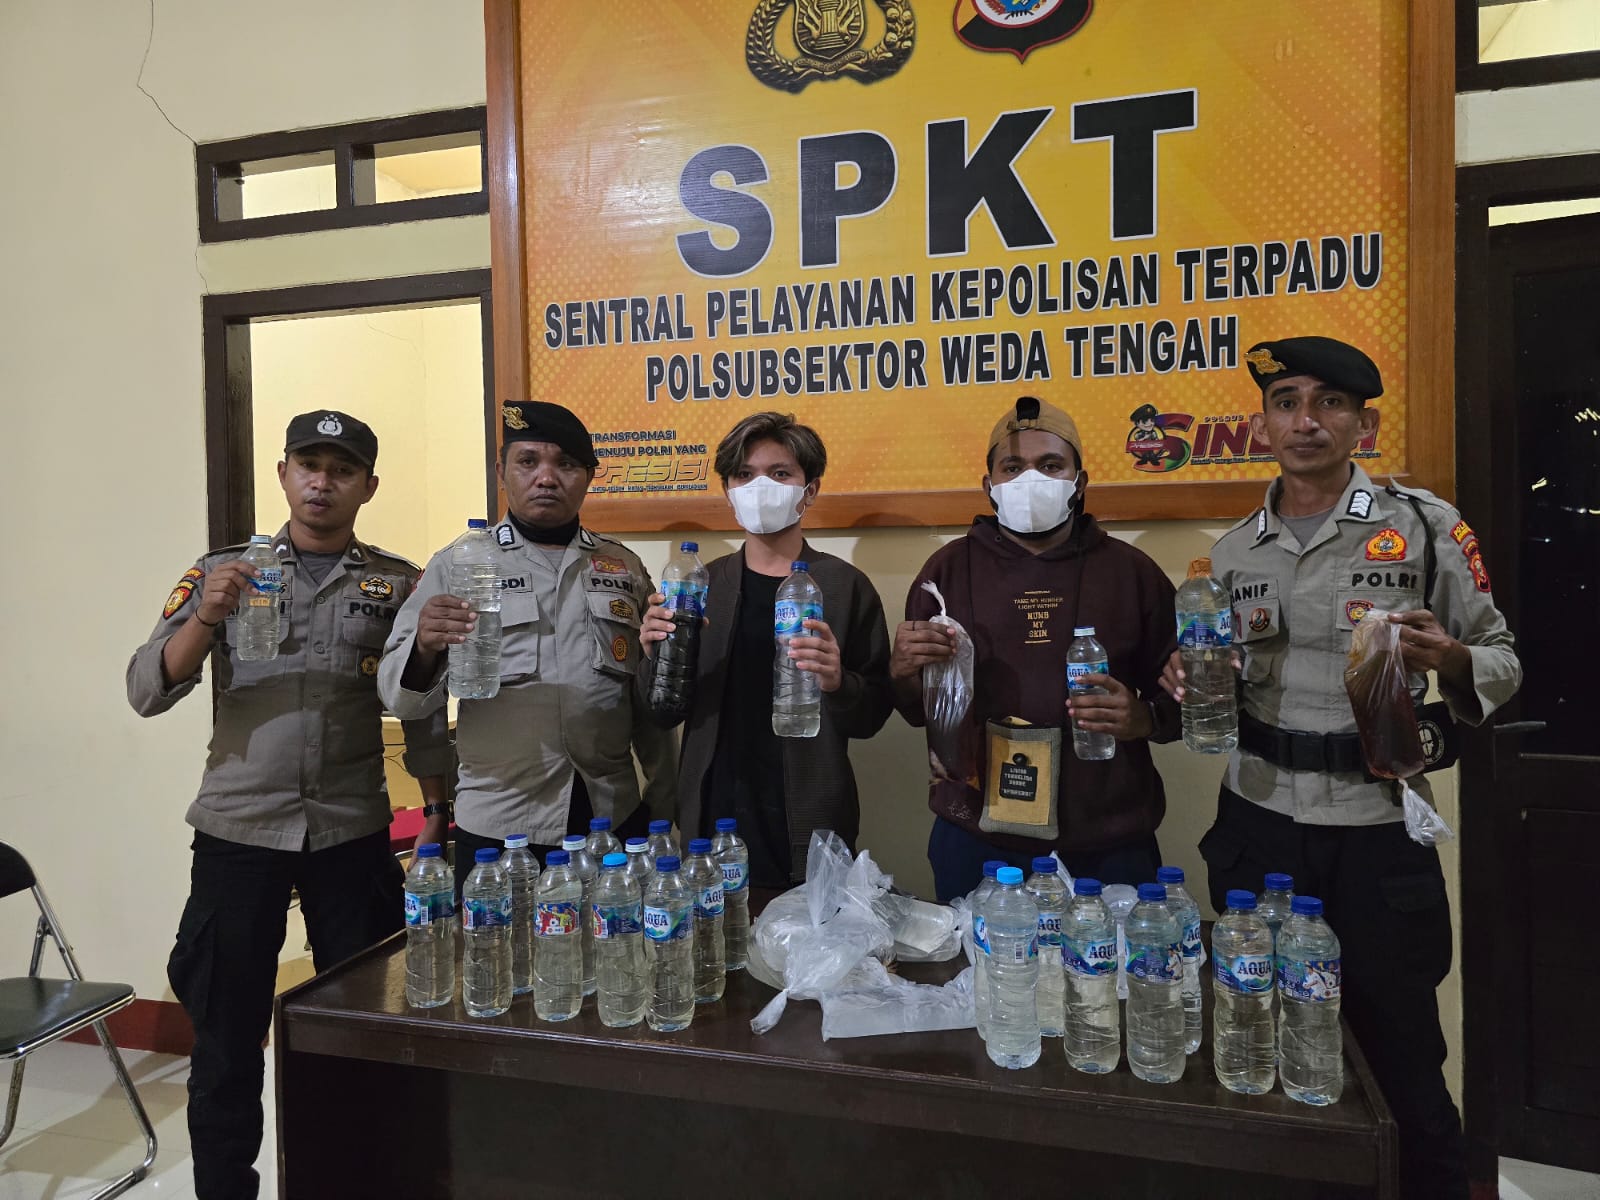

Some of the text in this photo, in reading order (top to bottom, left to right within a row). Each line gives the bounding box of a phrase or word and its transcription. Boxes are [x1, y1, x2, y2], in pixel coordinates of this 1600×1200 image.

[676, 89, 1198, 278] SPKT
[545, 233, 1383, 350] SENTRAL PELAYANAN KEPOLISAN TERPADU
[645, 315, 1239, 403] POLSUBSEKTOR WEDA TENGAH
[638, 445, 673, 457] POLRI
[675, 444, 708, 456] YANG
[260, 572, 281, 583] AQU
[1352, 572, 1418, 589] POLRI
[591, 578, 634, 593] POLRI
[1033, 620, 1044, 629] MY
[1028, 629, 1048, 638] SKIN
[705, 890, 724, 904] AQU
[1038, 918, 1062, 932] AQU
[1237, 960, 1272, 977] AQUA
